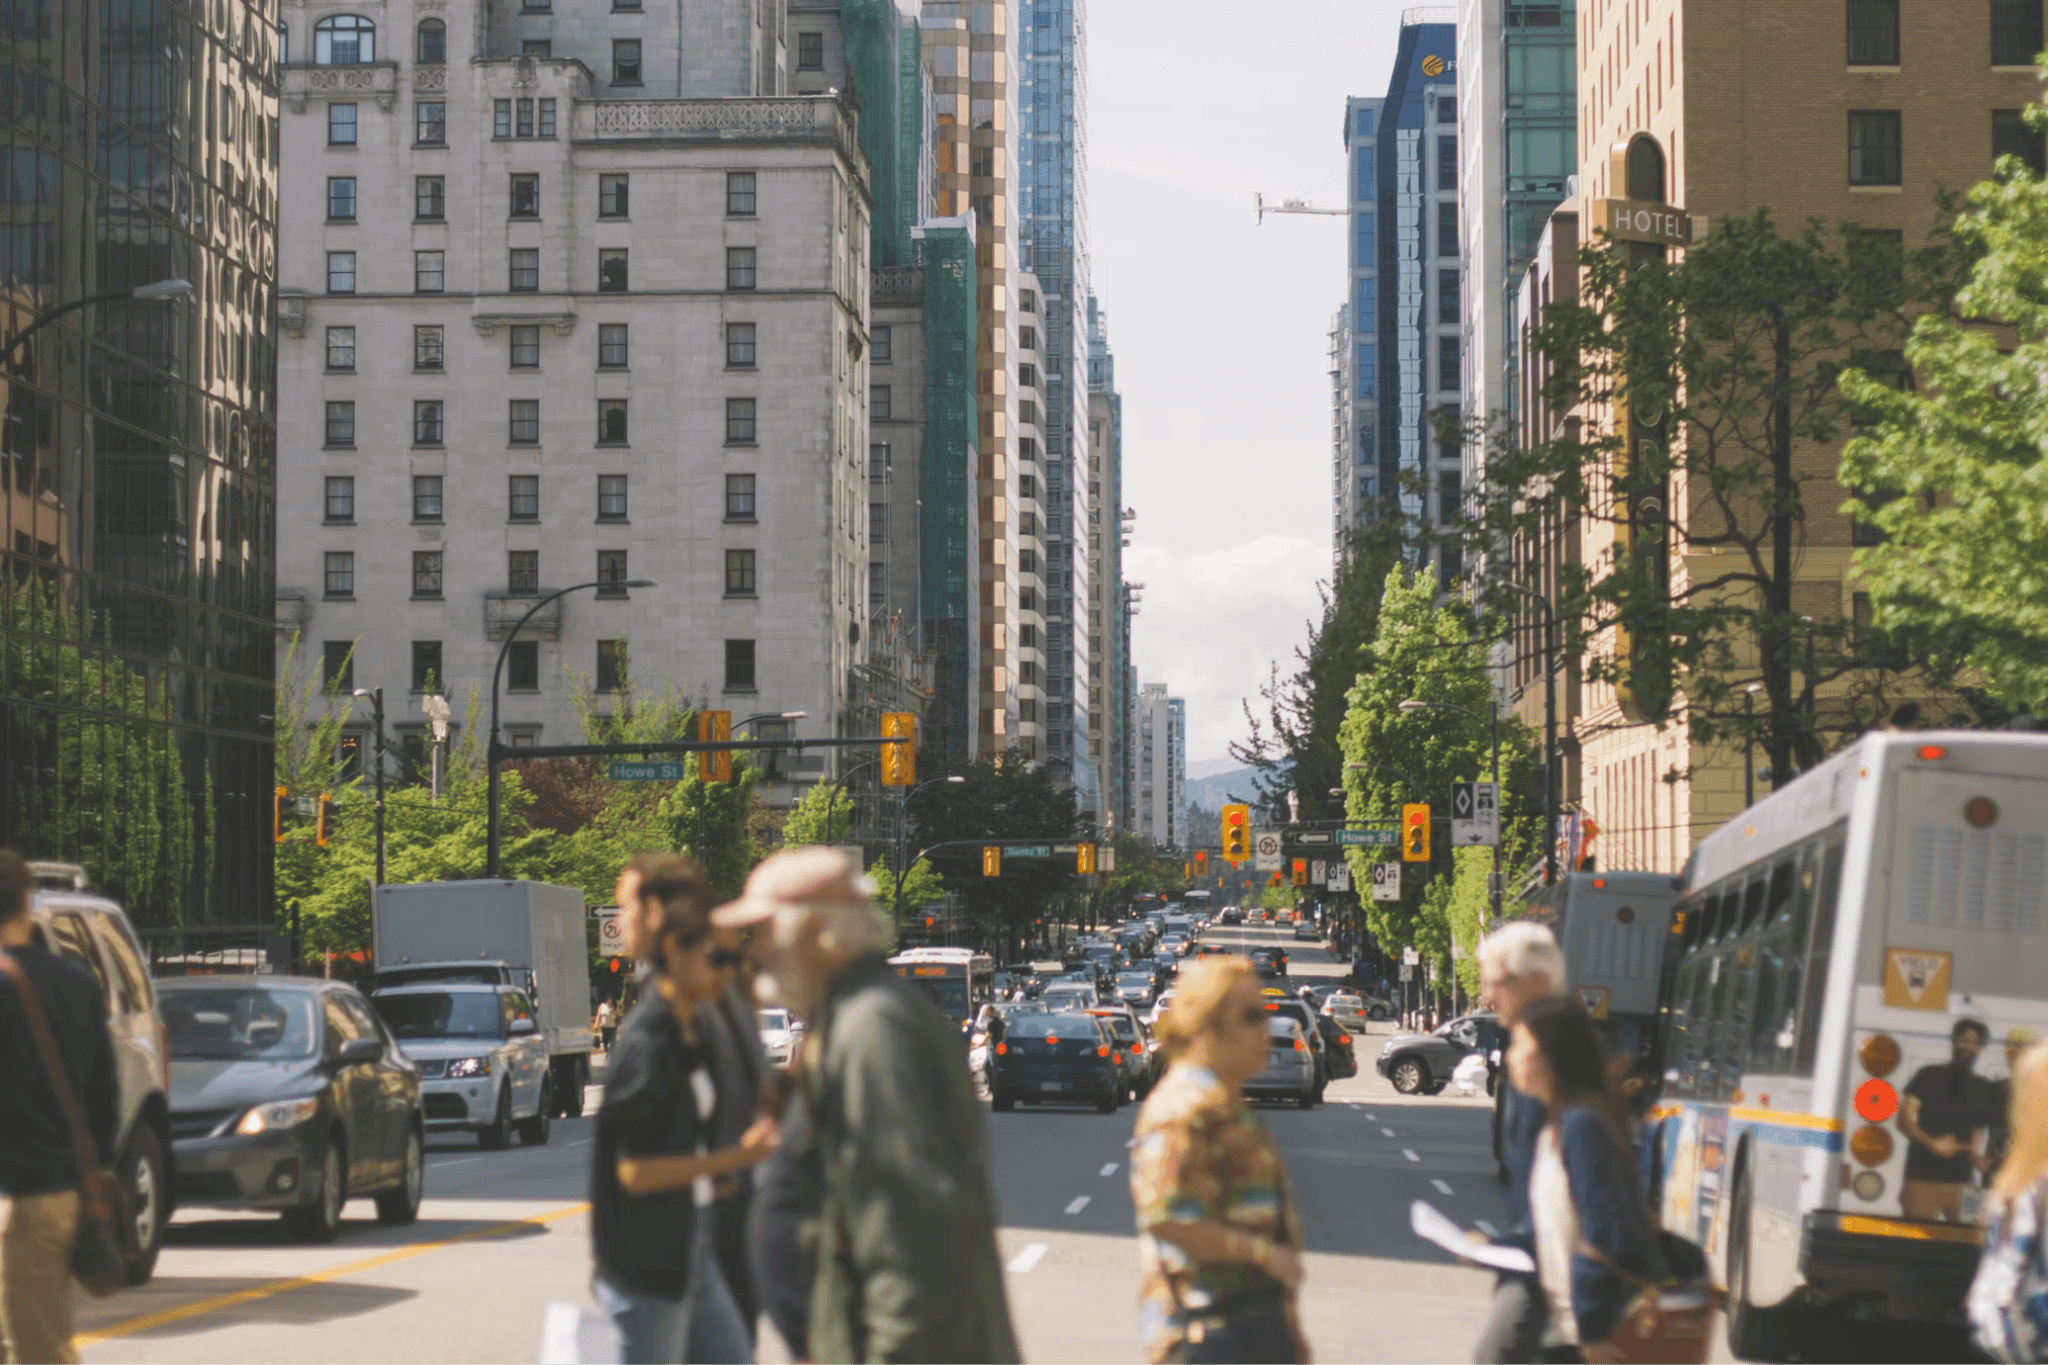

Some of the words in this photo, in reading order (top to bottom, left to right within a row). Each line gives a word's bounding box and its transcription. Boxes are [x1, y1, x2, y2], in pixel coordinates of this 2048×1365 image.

[1615, 208, 1683, 238] HOTEL
[614, 765, 655, 778] Howe
[661, 764, 678, 778] St
[1342, 832, 1374, 843] Howe
[1380, 832, 1392, 843] St
